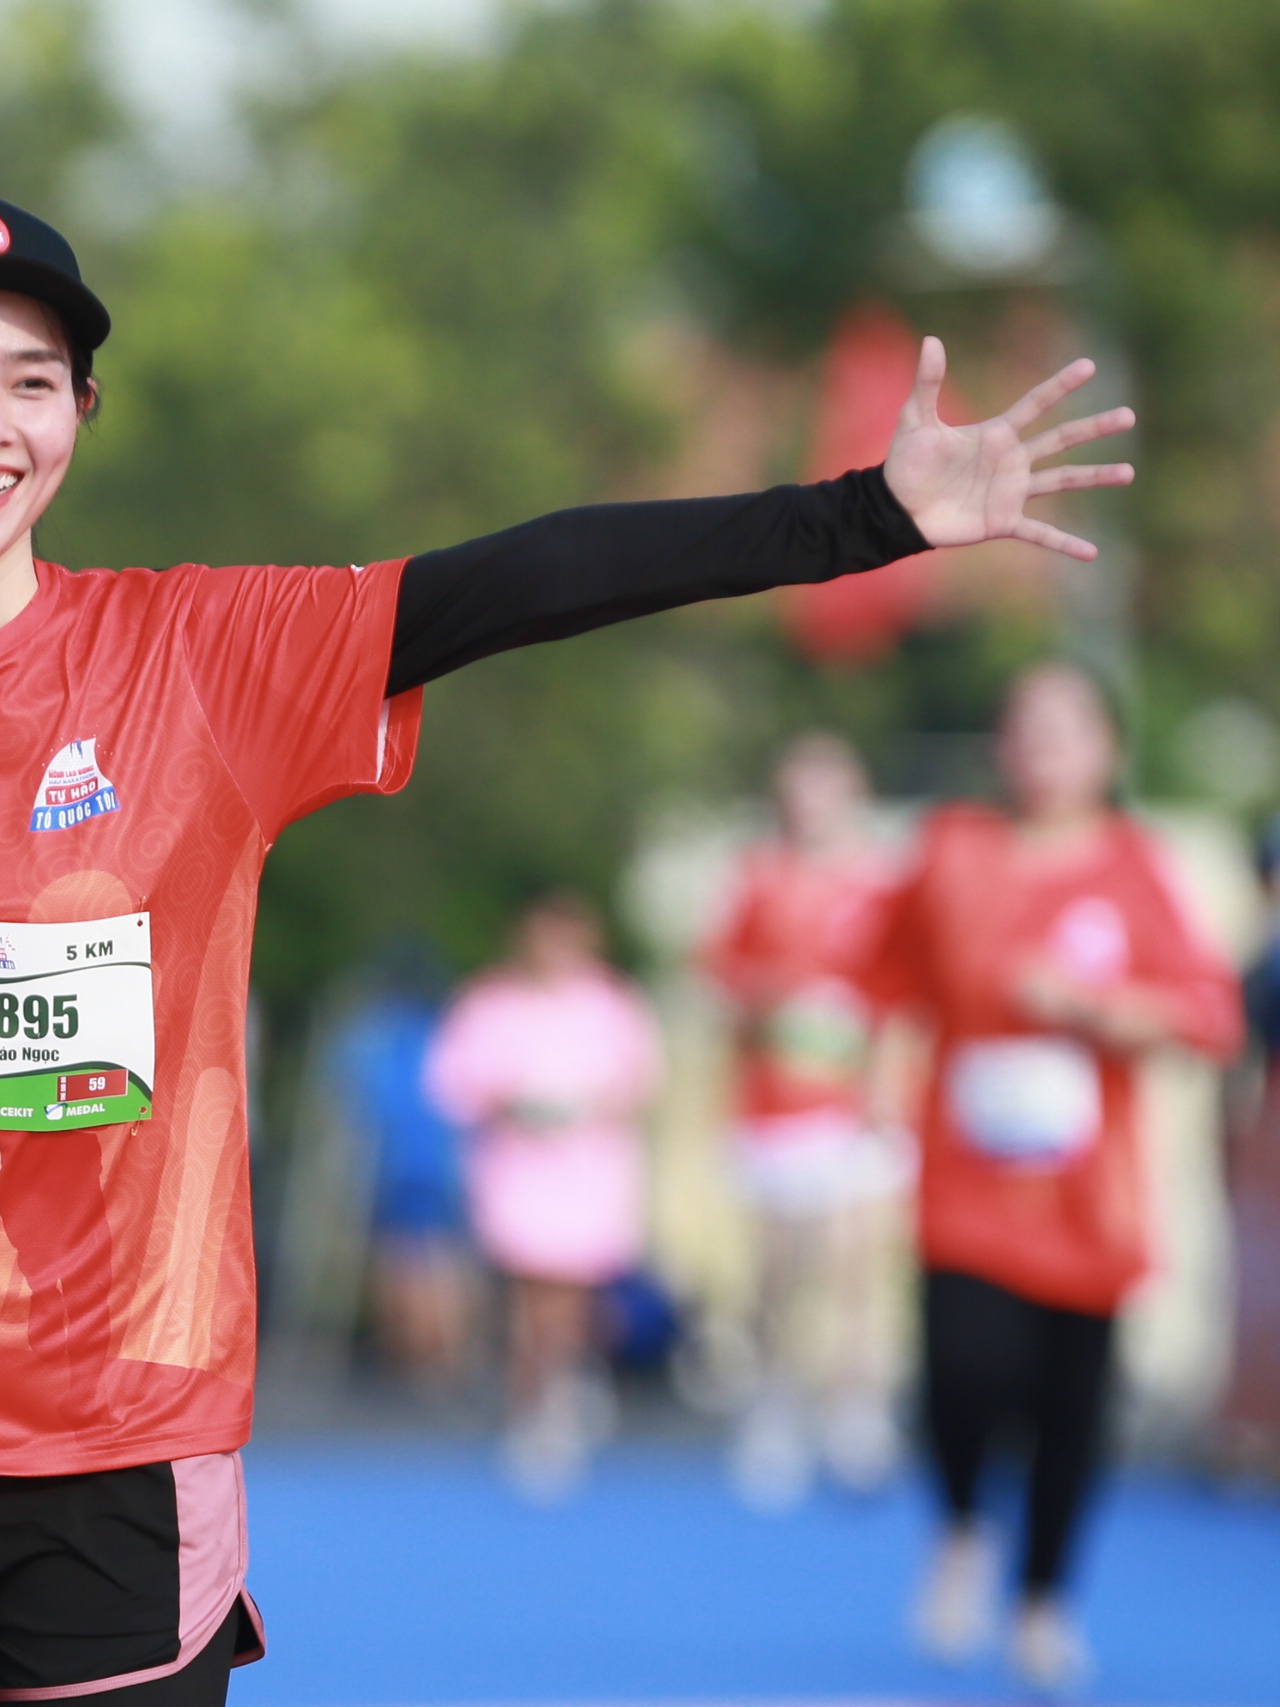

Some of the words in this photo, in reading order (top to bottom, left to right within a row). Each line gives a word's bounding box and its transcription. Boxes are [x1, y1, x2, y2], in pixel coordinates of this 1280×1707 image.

[66, 945, 77, 960] 5
[85, 940, 114, 959] KM
[22, 1047, 60, 1064] Ngọc
[88, 1076, 106, 1091] 59
[66, 1103, 106, 1117] MEDAL
